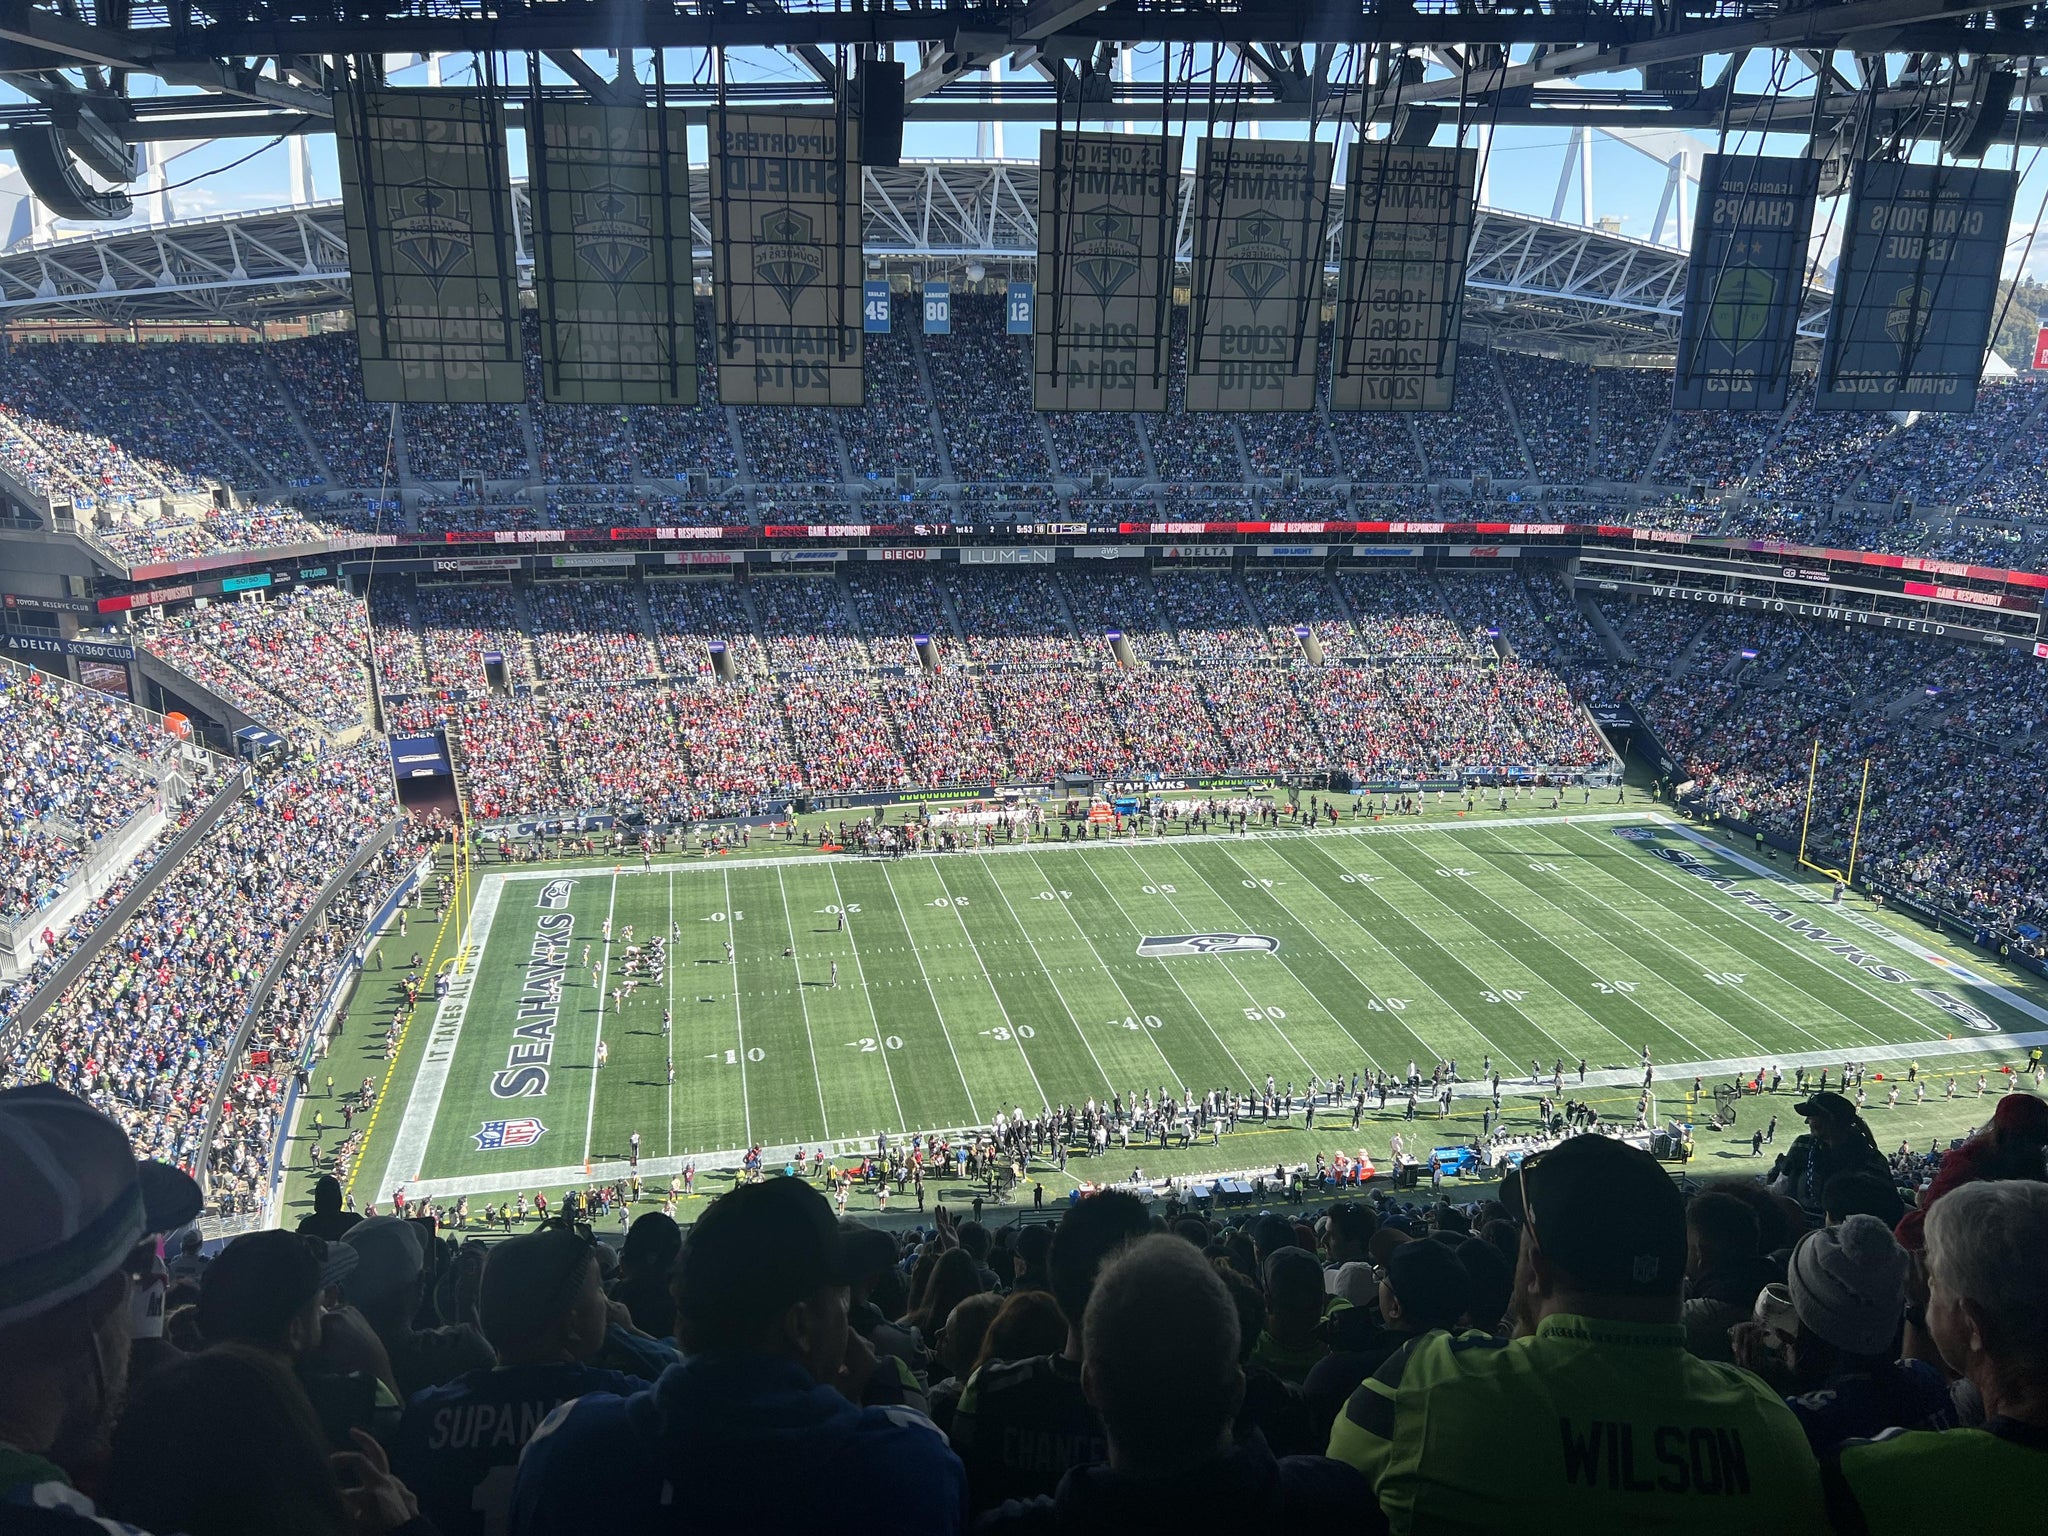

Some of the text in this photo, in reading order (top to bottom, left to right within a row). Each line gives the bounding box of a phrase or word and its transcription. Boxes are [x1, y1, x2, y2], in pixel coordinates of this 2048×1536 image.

[865, 301, 888, 321] 45
[925, 302, 948, 321] 80
[1011, 302, 1029, 321] 12
[794, 551, 839, 559] BOEING
[968, 549, 1048, 563] LUMEN
[1184, 547, 1228, 556] DELTA
[437, 561, 457, 571] EQC
[16, 599, 89, 612] TOYOTA RESERVE CLUB
[1652, 586, 1945, 635] WELCOME TO LUMEN FIELD
[20, 638, 61, 653] DELTA
[696, 676, 714, 684] 206
[466, 689, 486, 699] 204
[396, 731, 435, 740] LUMEN
[1895, 891, 1936, 917] SEAHAWKS
[1648, 847, 1917, 985] SEAHAWKS
[490, 912, 576, 1099] SEAHAWKS
[427, 979, 471, 1063] IT TAKES ALL
[504, 1118, 534, 1145] NFL
[428, 1400, 564, 1450] SUPAN
[1559, 1417, 1751, 1497] WILSON
